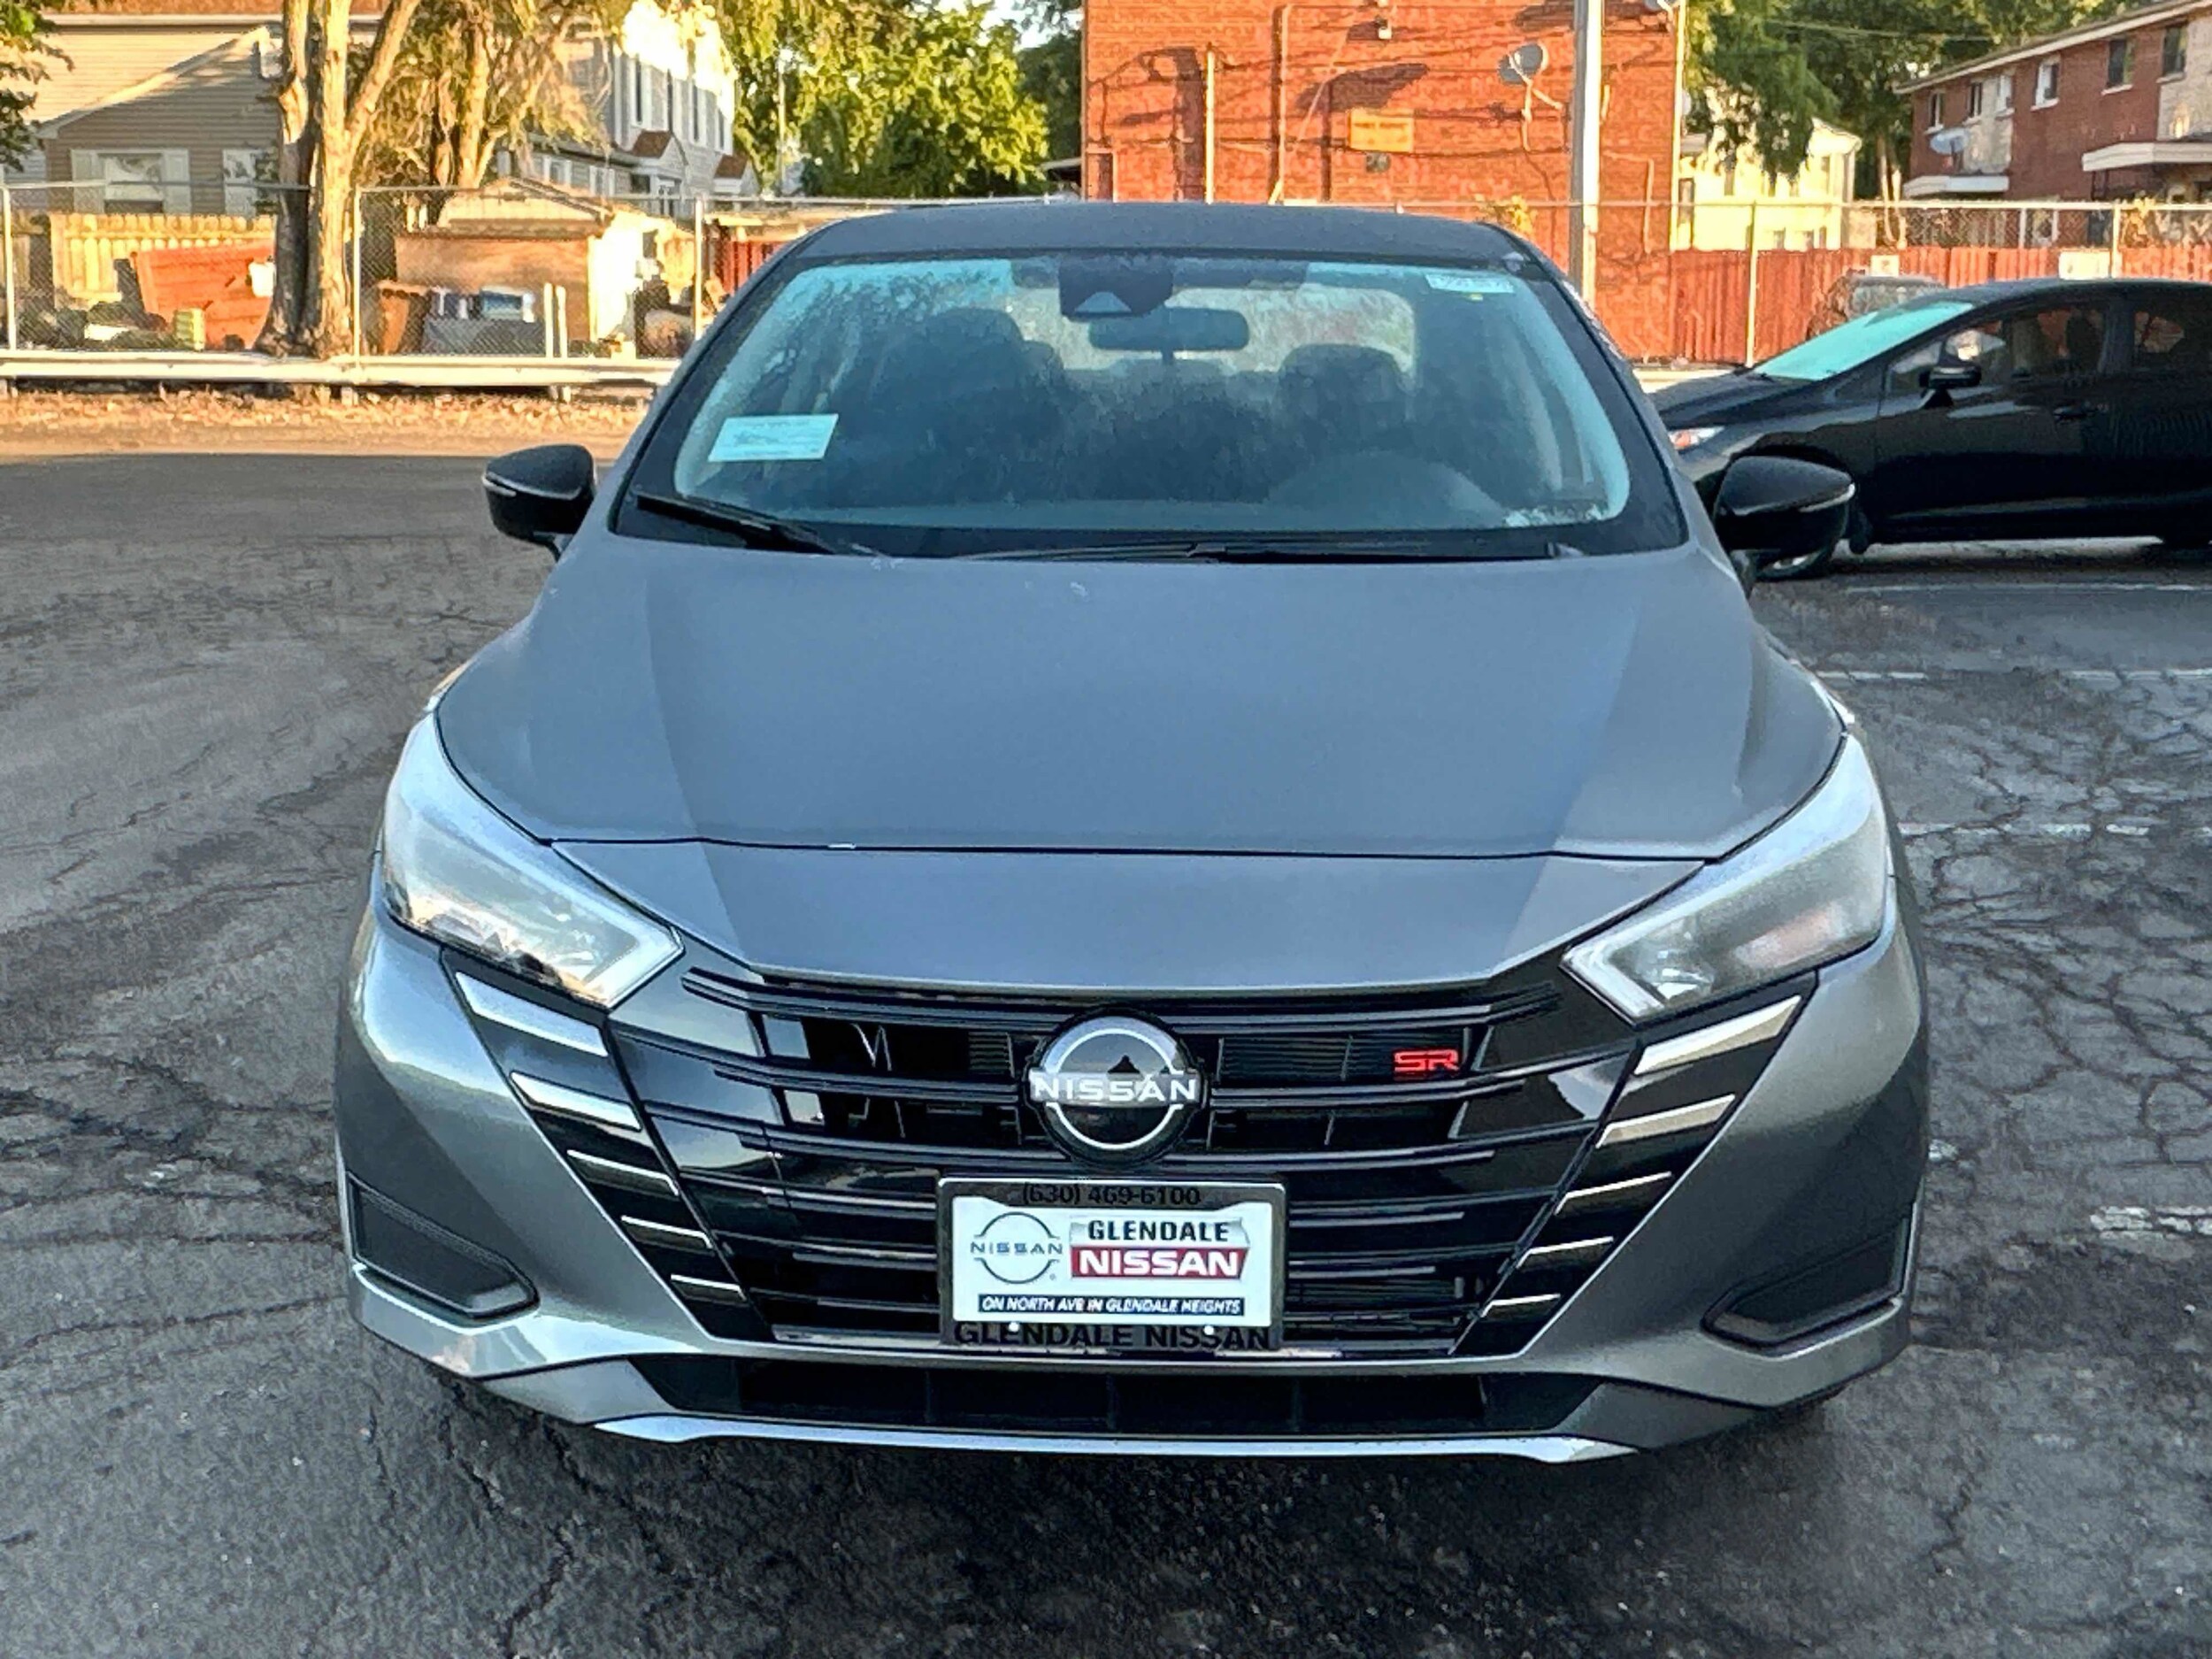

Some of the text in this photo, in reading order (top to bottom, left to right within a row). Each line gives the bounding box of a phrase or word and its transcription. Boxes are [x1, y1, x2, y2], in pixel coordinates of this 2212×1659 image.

[1393, 1048, 1460, 1075] SR
[1031, 1075, 1197, 1102] NISSAN
[1023, 1182, 1202, 1206] (630) 469-6100
[1088, 1219, 1229, 1242] GLENDALE
[971, 1240, 1063, 1255] NISSAN
[1079, 1248, 1239, 1277] NISSAN
[982, 1295, 1241, 1315] ON NORTH AVE IN GLENDALE HEIGHTS
[954, 1321, 1270, 1350] GLENDALE NISSAN
